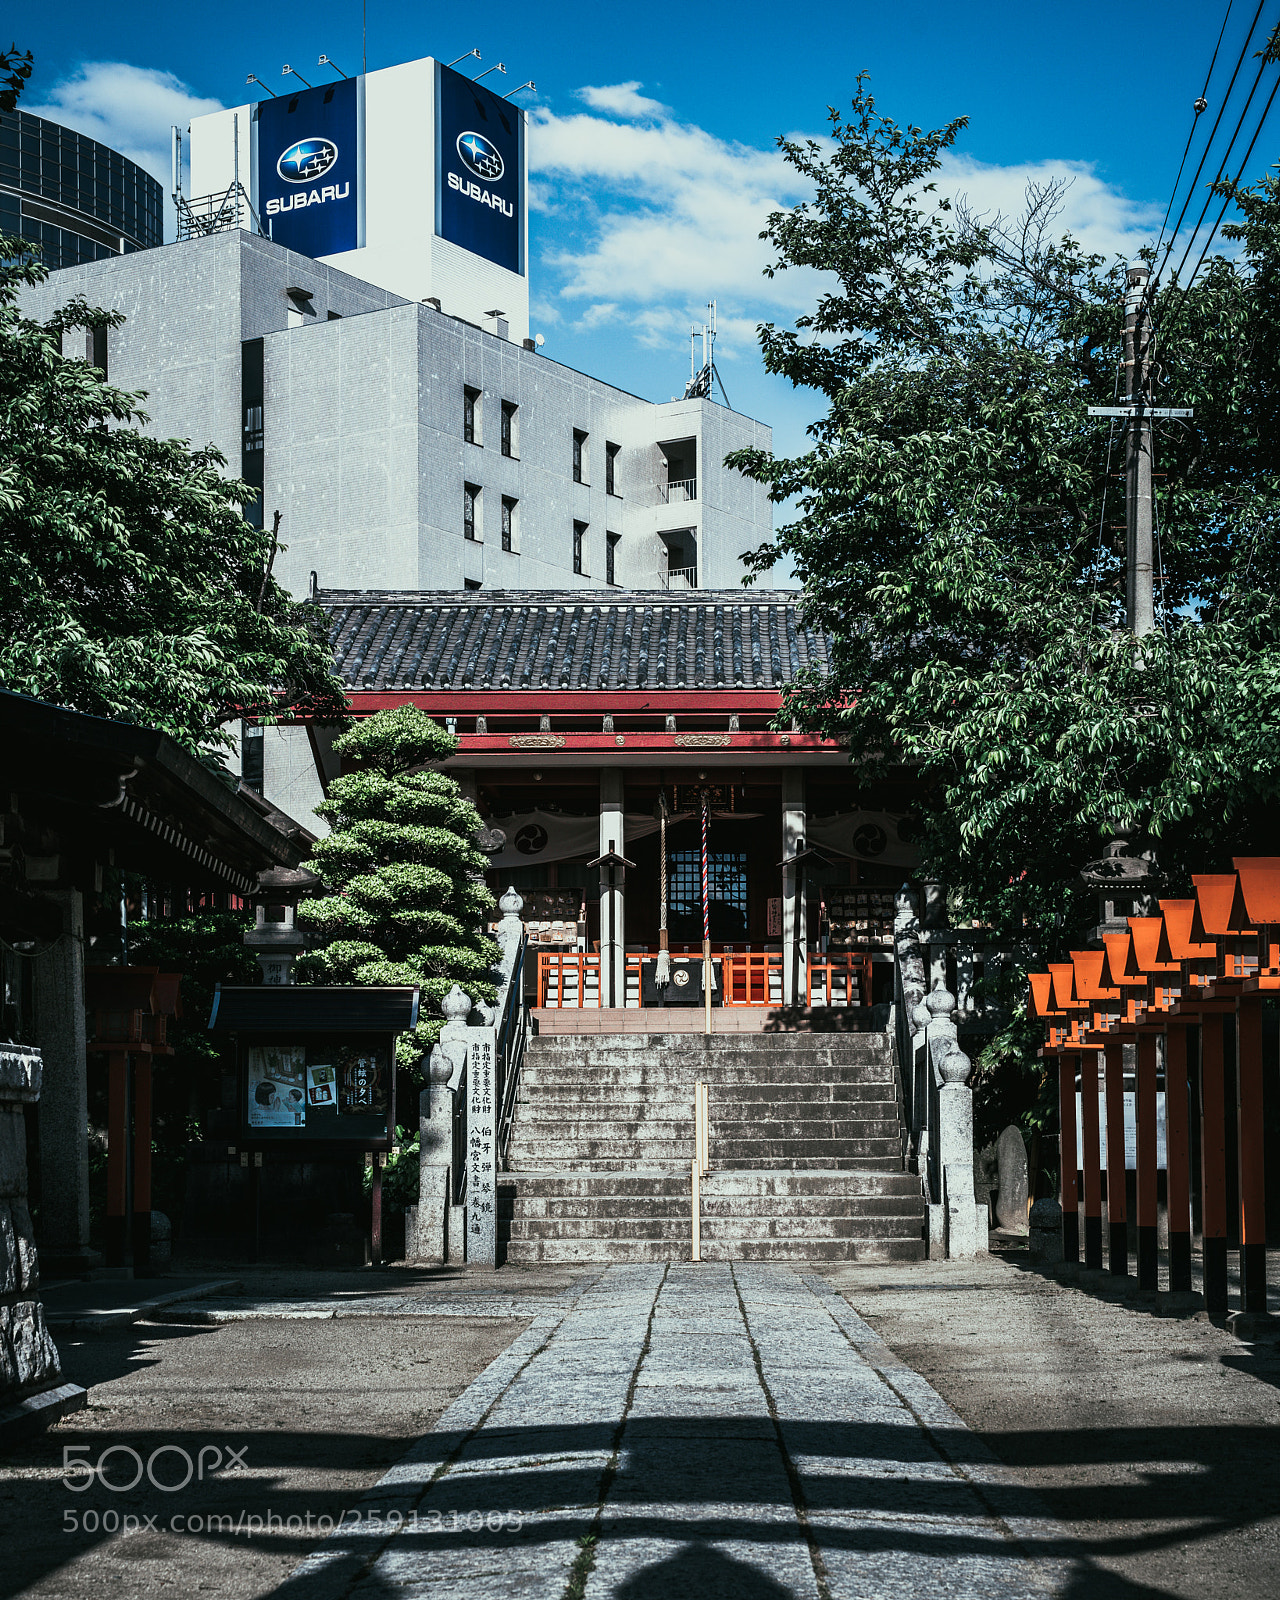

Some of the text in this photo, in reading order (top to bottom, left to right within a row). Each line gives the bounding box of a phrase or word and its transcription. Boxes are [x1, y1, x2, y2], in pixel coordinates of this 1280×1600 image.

[265, 181, 350, 216] SUBARU
[447, 171, 514, 218] SUBARU
[471, 1042, 481, 1114] 市指定重要文化財
[481, 1042, 492, 1114] 市指定重要文化財
